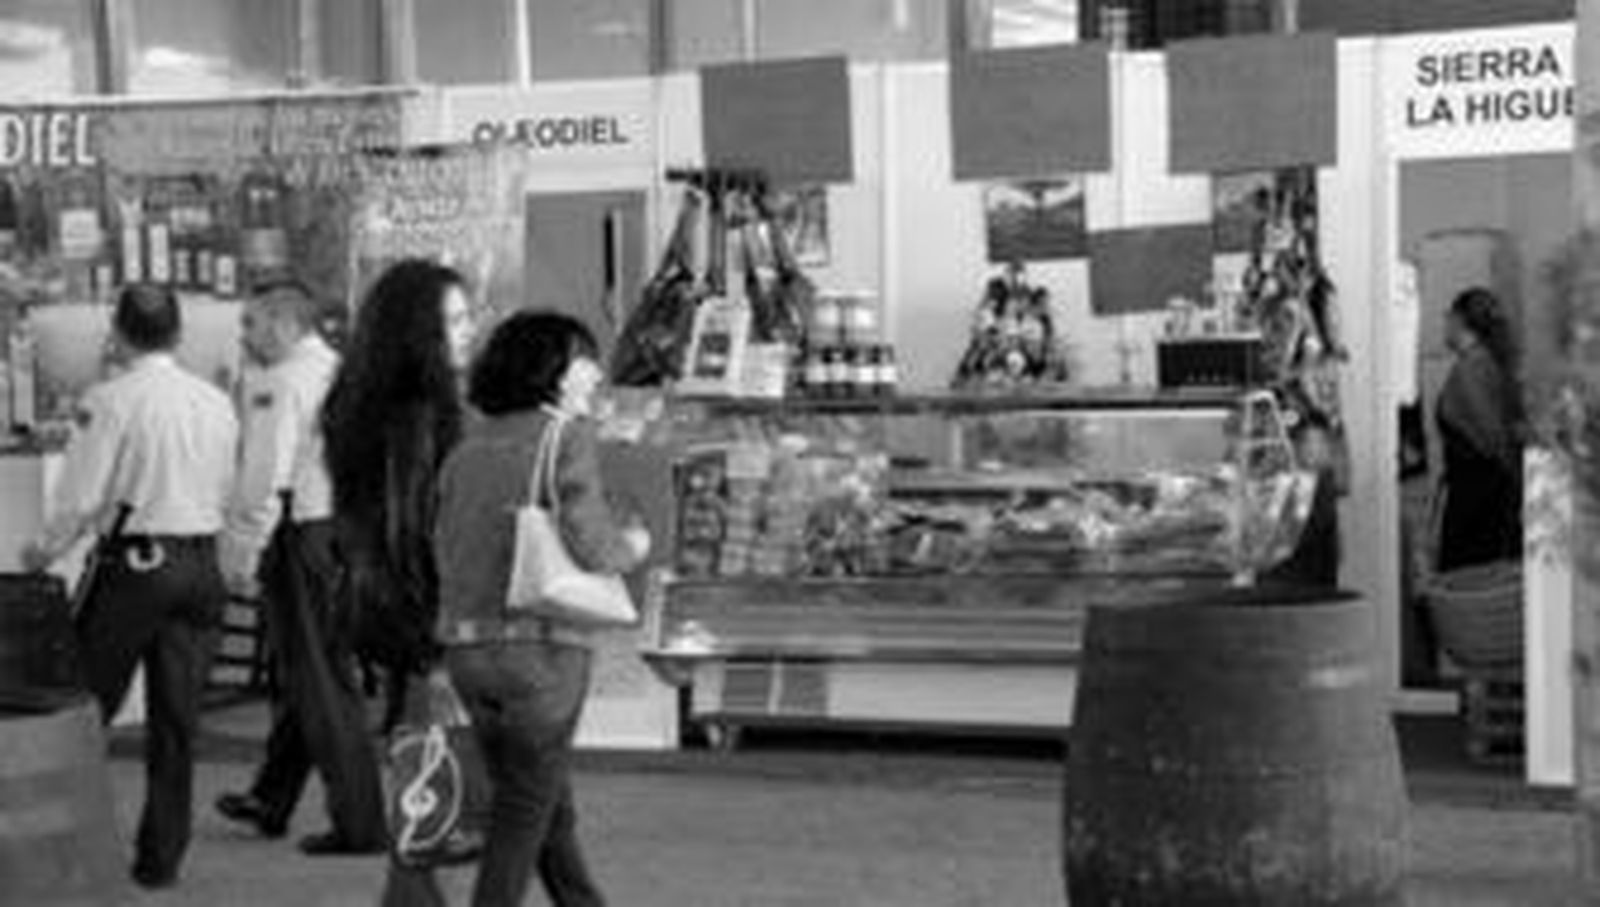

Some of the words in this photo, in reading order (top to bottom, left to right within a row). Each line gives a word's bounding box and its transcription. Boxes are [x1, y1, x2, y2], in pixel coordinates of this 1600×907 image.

[1416, 46, 1560, 87] SIERRA
[1407, 95, 1453, 127] LA
[0, 113, 96, 166] DIEL
